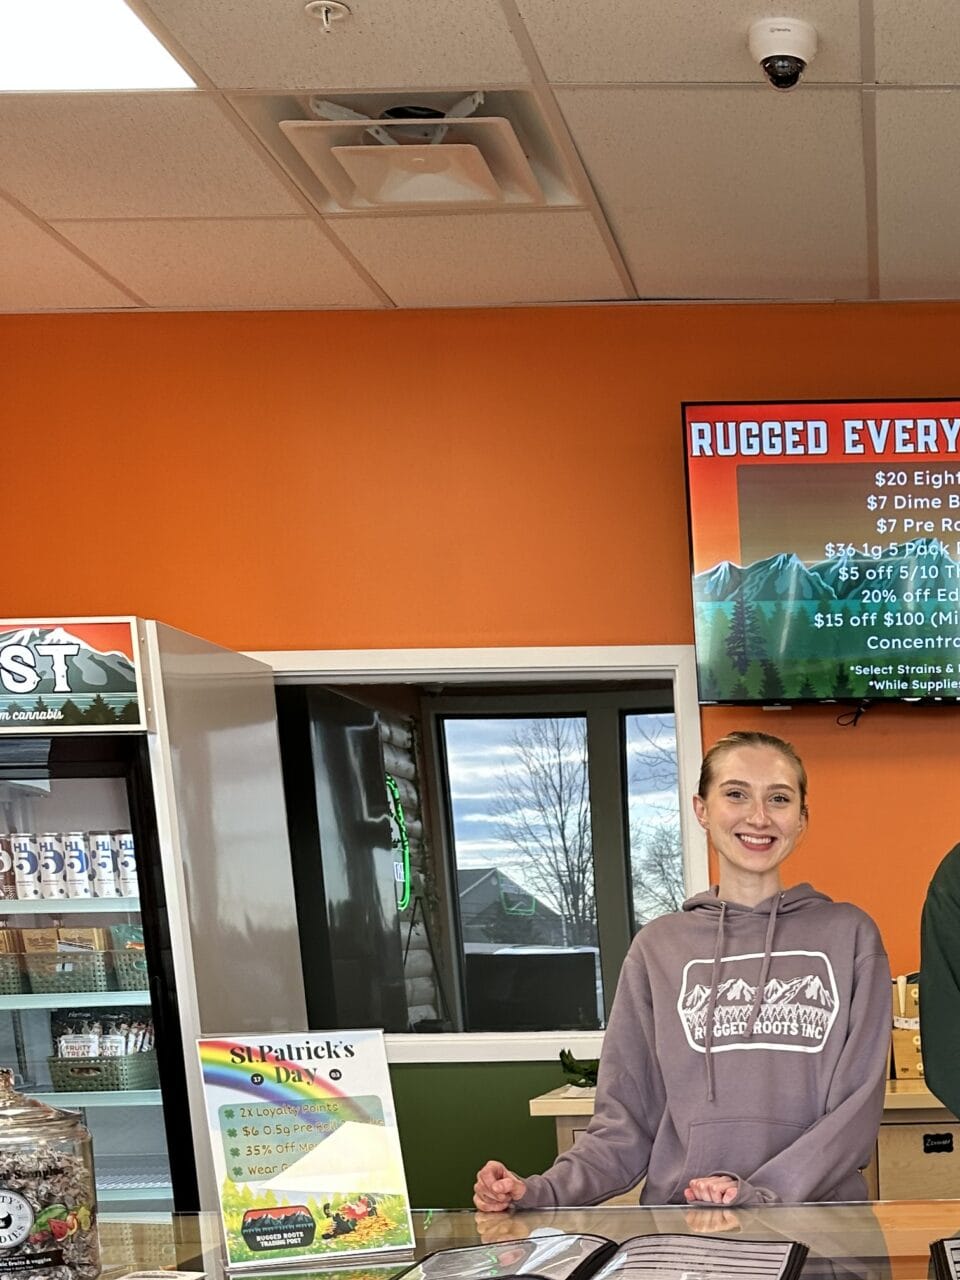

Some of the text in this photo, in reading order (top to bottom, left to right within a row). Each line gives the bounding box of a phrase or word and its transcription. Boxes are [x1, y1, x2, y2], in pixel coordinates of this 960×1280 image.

[690, 420, 829, 457] RUGGED
[875, 471, 908, 487] $20
[867, 495, 887, 511] $7
[894, 494, 942, 510] Dime
[876, 519, 897, 535] $7
[903, 518, 935, 533] Pre
[825, 543, 856, 559] $36
[863, 543, 883, 560] 1g
[889, 542, 899, 556] 5
[906, 541, 950, 557] Pack
[838, 566, 860, 582] $5
[865, 565, 893, 580] off
[900, 565, 939, 581] 5/10
[861, 589, 897, 604] 20%
[903, 588, 931, 602] off
[814, 613, 844, 629] $15
[850, 612, 878, 627] off
[884, 612, 925, 628] $100
[897, 665, 942, 676] Strains
[945, 664, 954, 675] &
[12, 708, 65, 721] cannabis
[753, 1020, 799, 1036] ROOTS
[801, 1023, 824, 1040] INC
[274, 1066, 318, 1085] Day
[256, 1102, 298, 1118] Loyalty
[302, 1103, 340, 1114] Points
[241, 1125, 260, 1137] $6
[263, 1124, 291, 1137] 0.5g
[293, 1123, 313, 1134] Pre
[245, 1144, 273, 1157] 35%
[275, 1142, 296, 1154] Off
[247, 1165, 278, 1176] Wear
